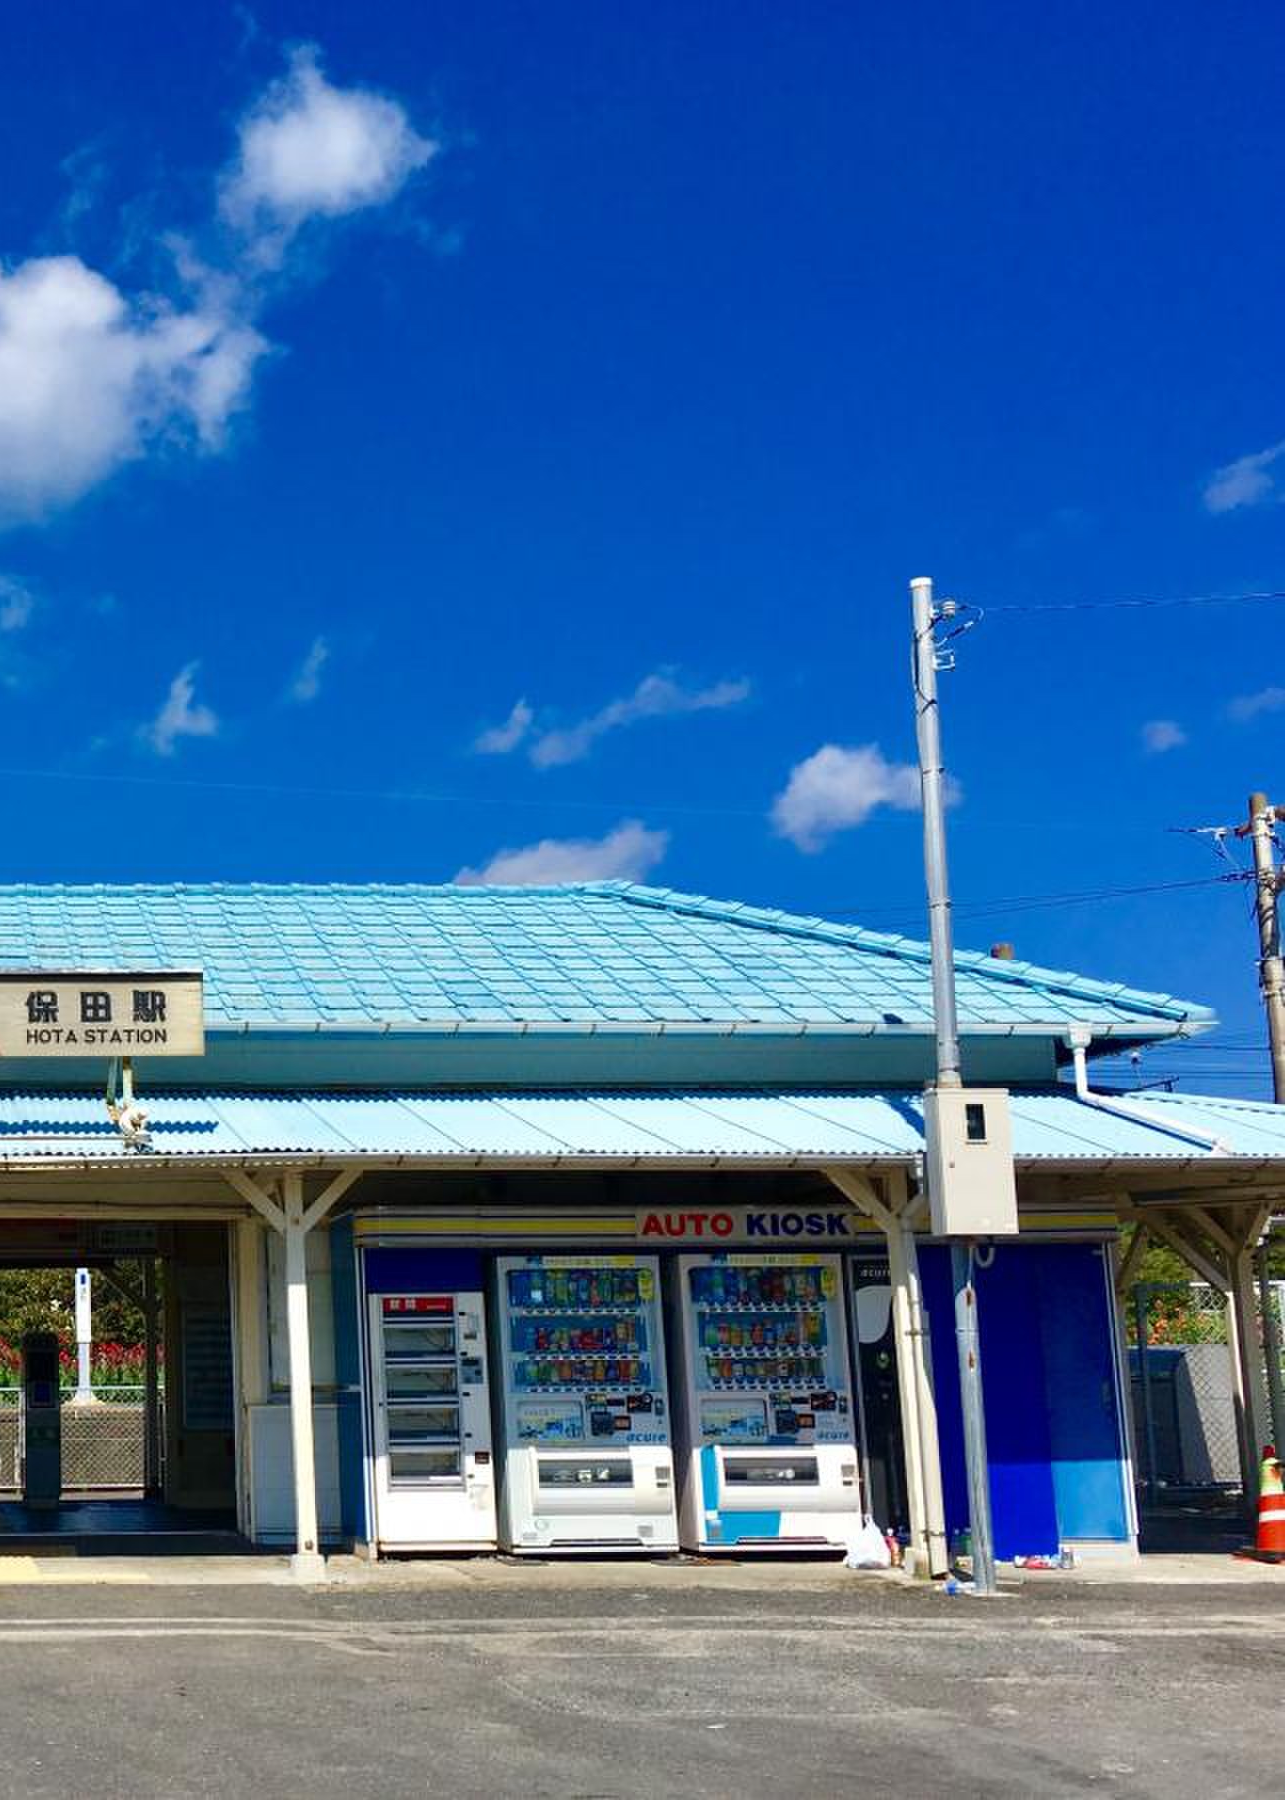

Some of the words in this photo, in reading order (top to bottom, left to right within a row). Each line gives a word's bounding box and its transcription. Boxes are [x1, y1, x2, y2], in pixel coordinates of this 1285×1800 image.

[25, 990, 167, 1023] 保田駅
[26, 1029, 78, 1044] HOTA
[84, 1029, 167, 1044] STATION
[643, 1213, 733, 1236] AUTO
[746, 1213, 849, 1236] KIOSK
[626, 1431, 667, 1442] acure
[816, 1429, 850, 1440] acure
